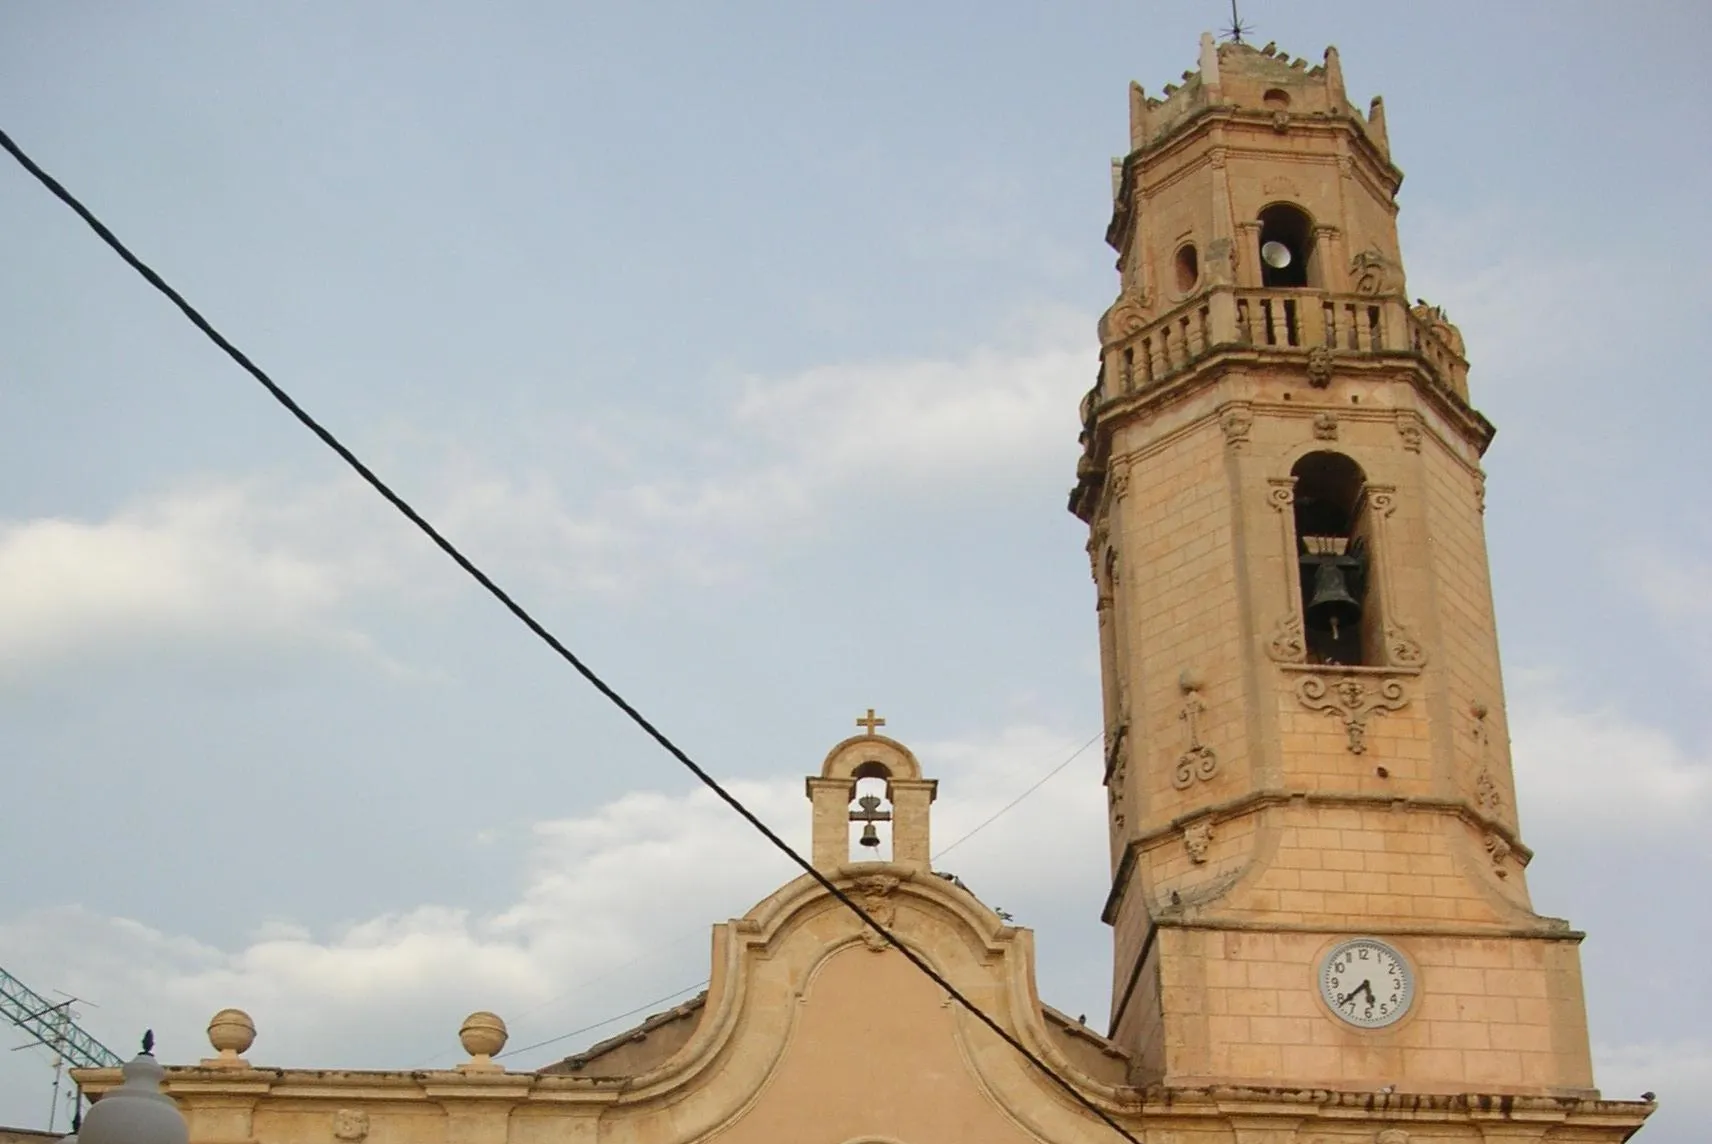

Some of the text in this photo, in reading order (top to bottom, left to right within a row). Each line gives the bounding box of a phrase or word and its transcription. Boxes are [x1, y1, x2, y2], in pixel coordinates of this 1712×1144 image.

[1346, 952, 1352, 963] 11
[1359, 949, 1369, 960] 12
[1335, 962, 1345, 973] 10
[1388, 963, 1396, 974] 2
[1331, 977, 1339, 988] 9
[1393, 979, 1401, 990] 3
[1337, 993, 1344, 1004] 8
[1390, 993, 1397, 1004] 4
[1349, 1003, 1356, 1015] 7
[1364, 1008, 1372, 1018] 6
[1380, 1003, 1388, 1014] 5
